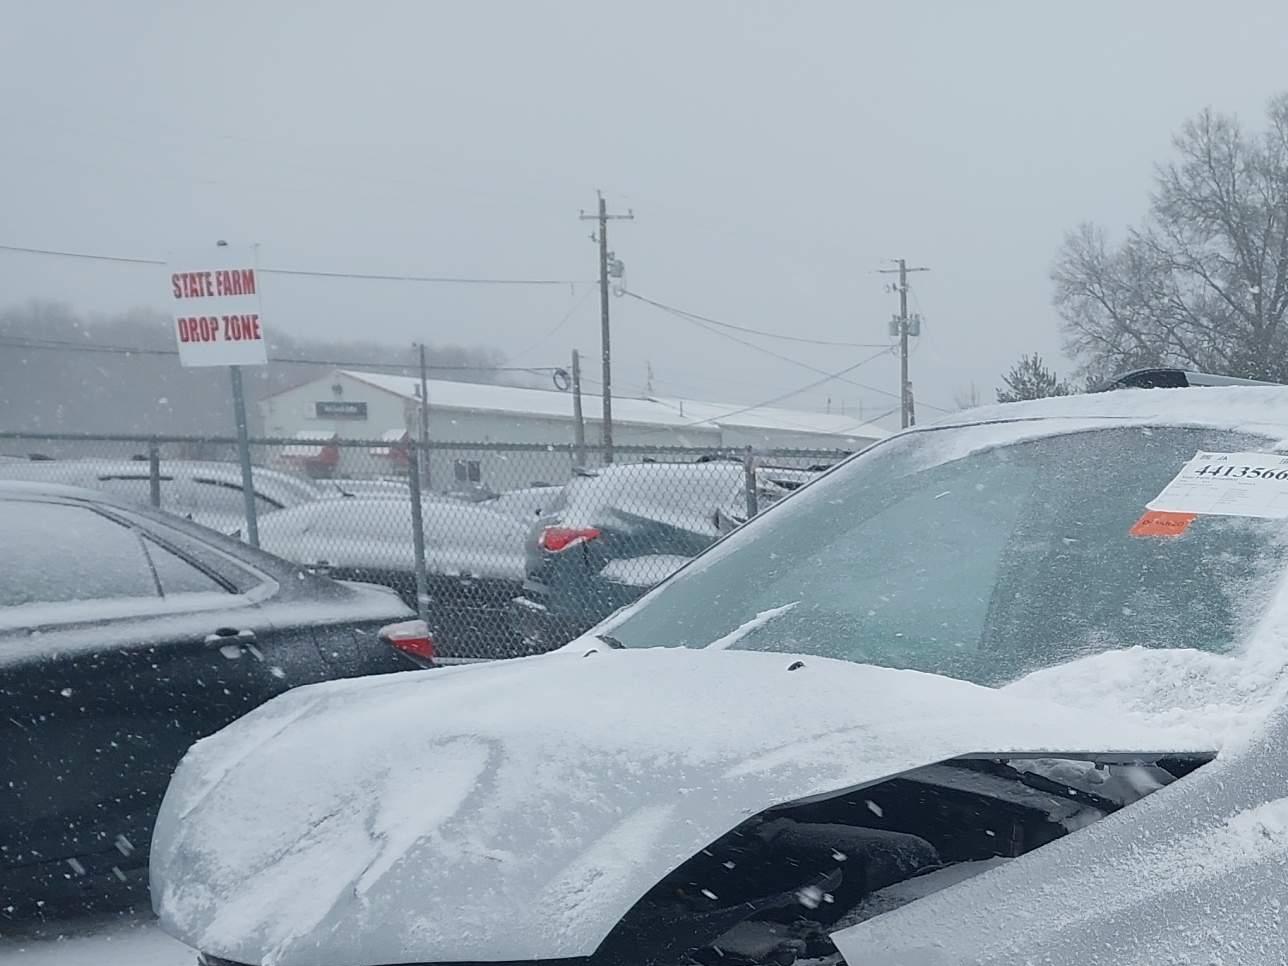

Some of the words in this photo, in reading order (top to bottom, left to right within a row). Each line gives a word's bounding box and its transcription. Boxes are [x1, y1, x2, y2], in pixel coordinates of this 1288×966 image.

[171, 271, 214, 299] STATE
[215, 268, 256, 296] FARM
[177, 316, 219, 342] DROP
[222, 314, 261, 341] ZONE
